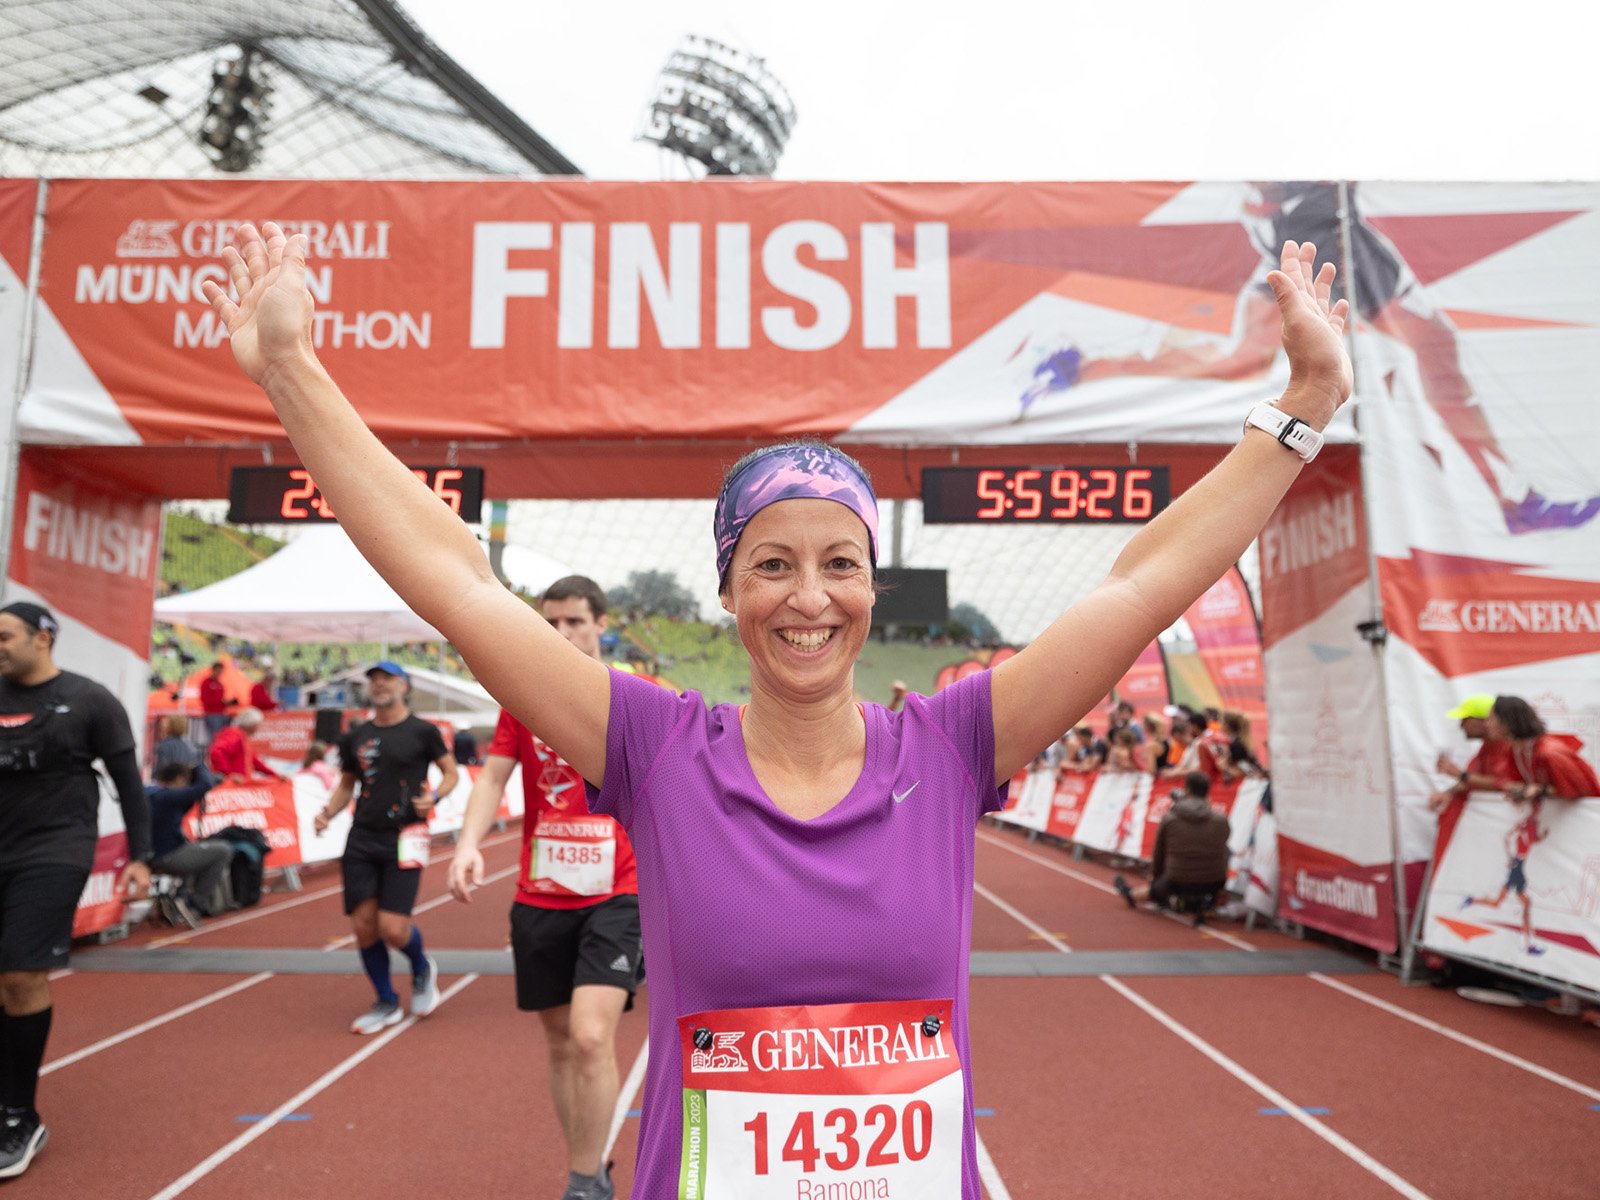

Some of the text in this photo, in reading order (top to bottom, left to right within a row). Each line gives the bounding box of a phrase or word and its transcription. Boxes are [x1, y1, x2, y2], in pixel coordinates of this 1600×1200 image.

[182, 220, 391, 259] GERALI
[75, 265, 332, 304] MÜNCN
[470, 220, 952, 351] FINISH
[977, 470, 1152, 518] 5:59:26
[24, 491, 153, 580] FINISH
[1263, 492, 1356, 579] FINISH
[1460, 600, 1600, 633] GENERA
[547, 846, 602, 865] 14385
[752, 1021, 950, 1071] GENERALI
[686, 1094, 701, 1200] MARATHON 2023
[744, 1100, 933, 1175] 14320
[797, 1177, 890, 1200] Ramona
